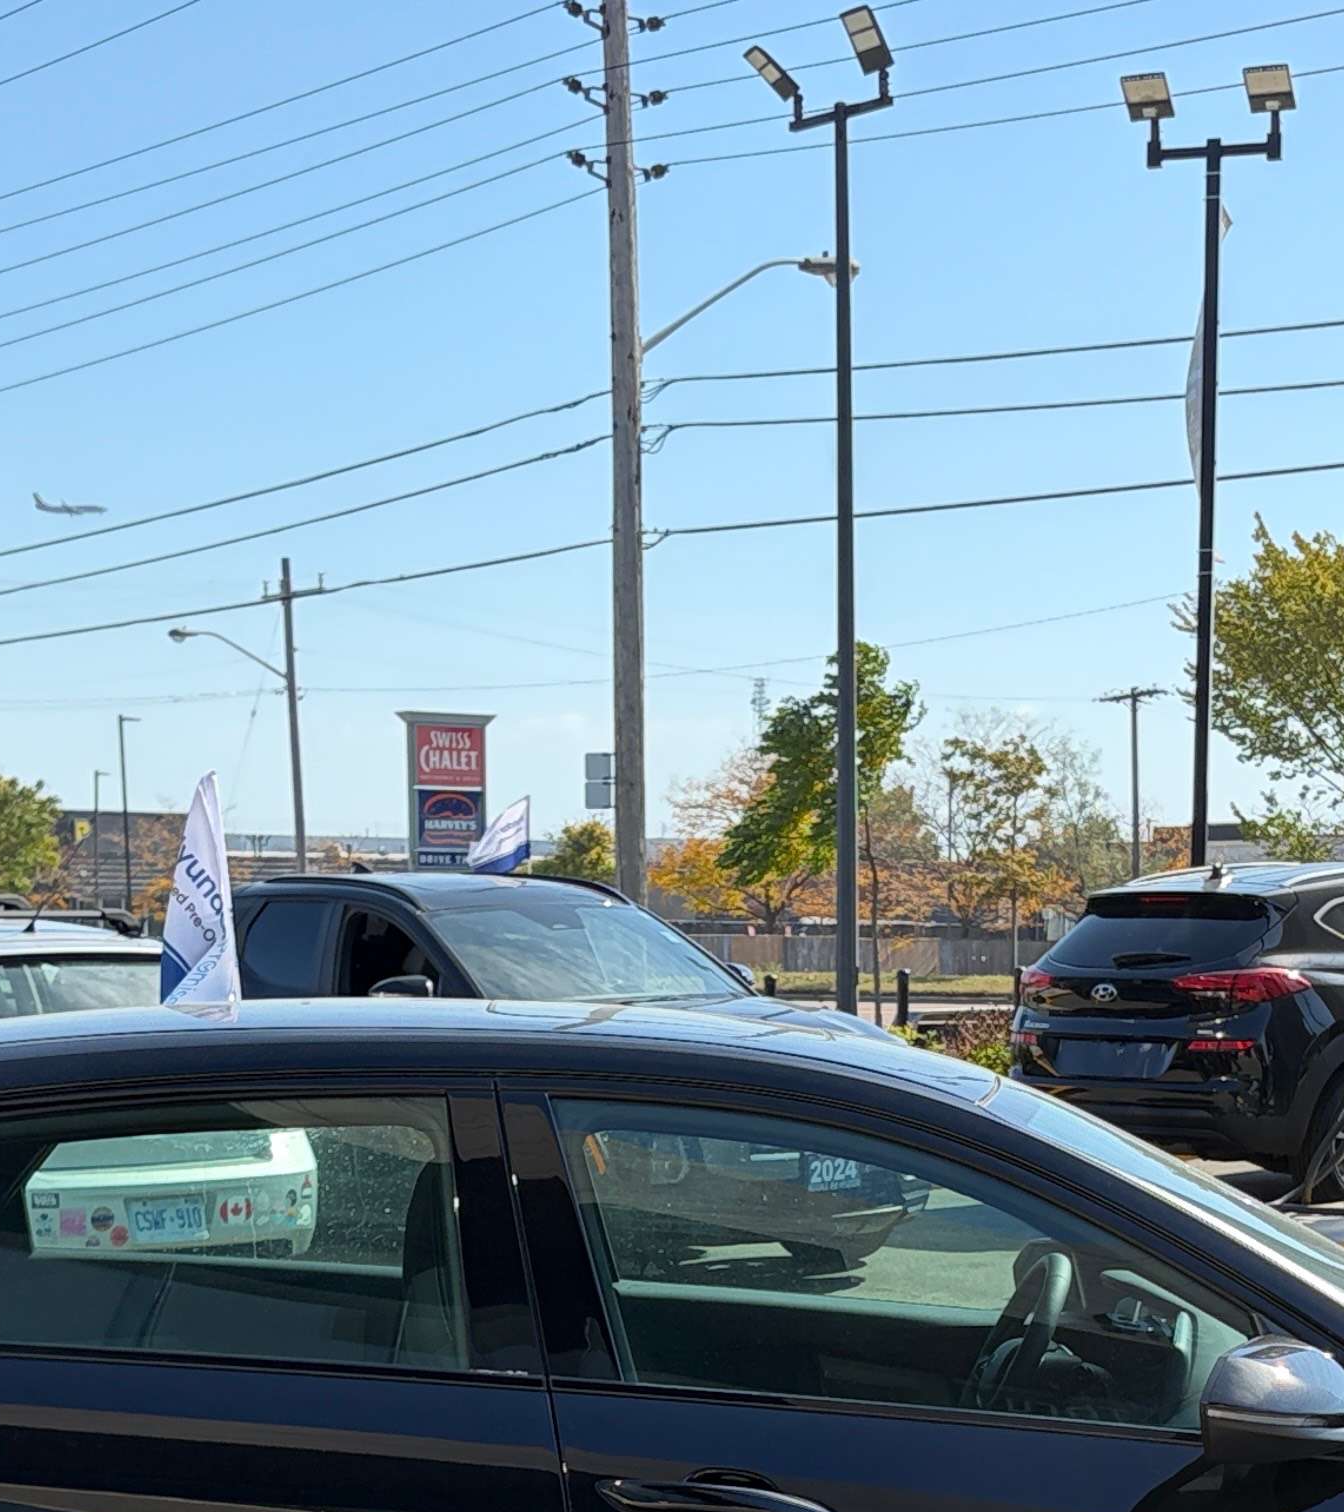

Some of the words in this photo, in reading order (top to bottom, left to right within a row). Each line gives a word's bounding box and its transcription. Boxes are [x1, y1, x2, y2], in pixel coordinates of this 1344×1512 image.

[429, 730, 472, 750] SWISS
[419, 745, 479, 773] CHALET
[809, 1158, 858, 1184] 2024
